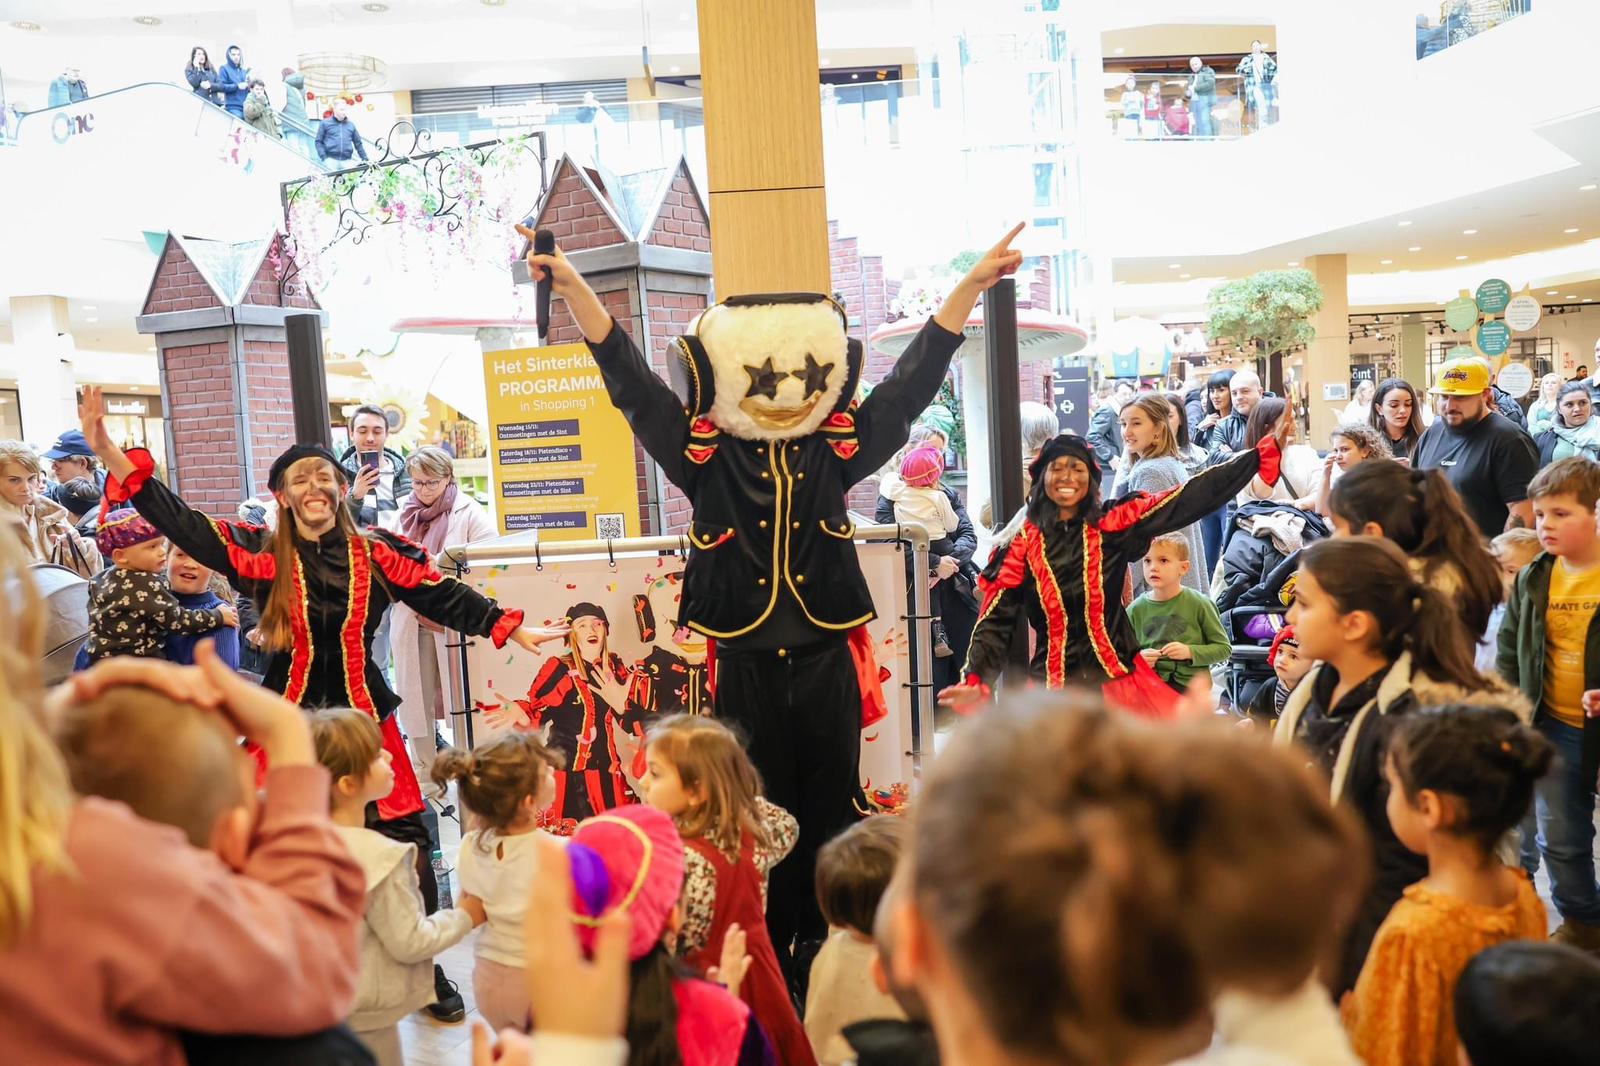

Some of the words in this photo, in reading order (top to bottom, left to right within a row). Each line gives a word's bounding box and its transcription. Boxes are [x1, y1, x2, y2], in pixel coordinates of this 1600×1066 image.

[494, 361, 522, 374] Het
[527, 353, 598, 372] Sinterkla
[520, 400, 530, 412] in
[533, 398, 587, 412] Shopping
[590, 396, 595, 407] 1
[499, 424, 525, 432] Woensdag
[499, 431, 537, 439] Ontmoetingen
[500, 449, 524, 457] Zaterdag
[538, 447, 569, 455] Pietendisco
[501, 456, 538, 464] ontmoetingen
[503, 481, 530, 489] Woensdag
[545, 479, 576, 487] Pietendisco
[504, 488, 541, 497] ontmoetingen
[506, 521, 545, 529] Ontmoetingen
[1550, 603, 1579, 611] MATE
